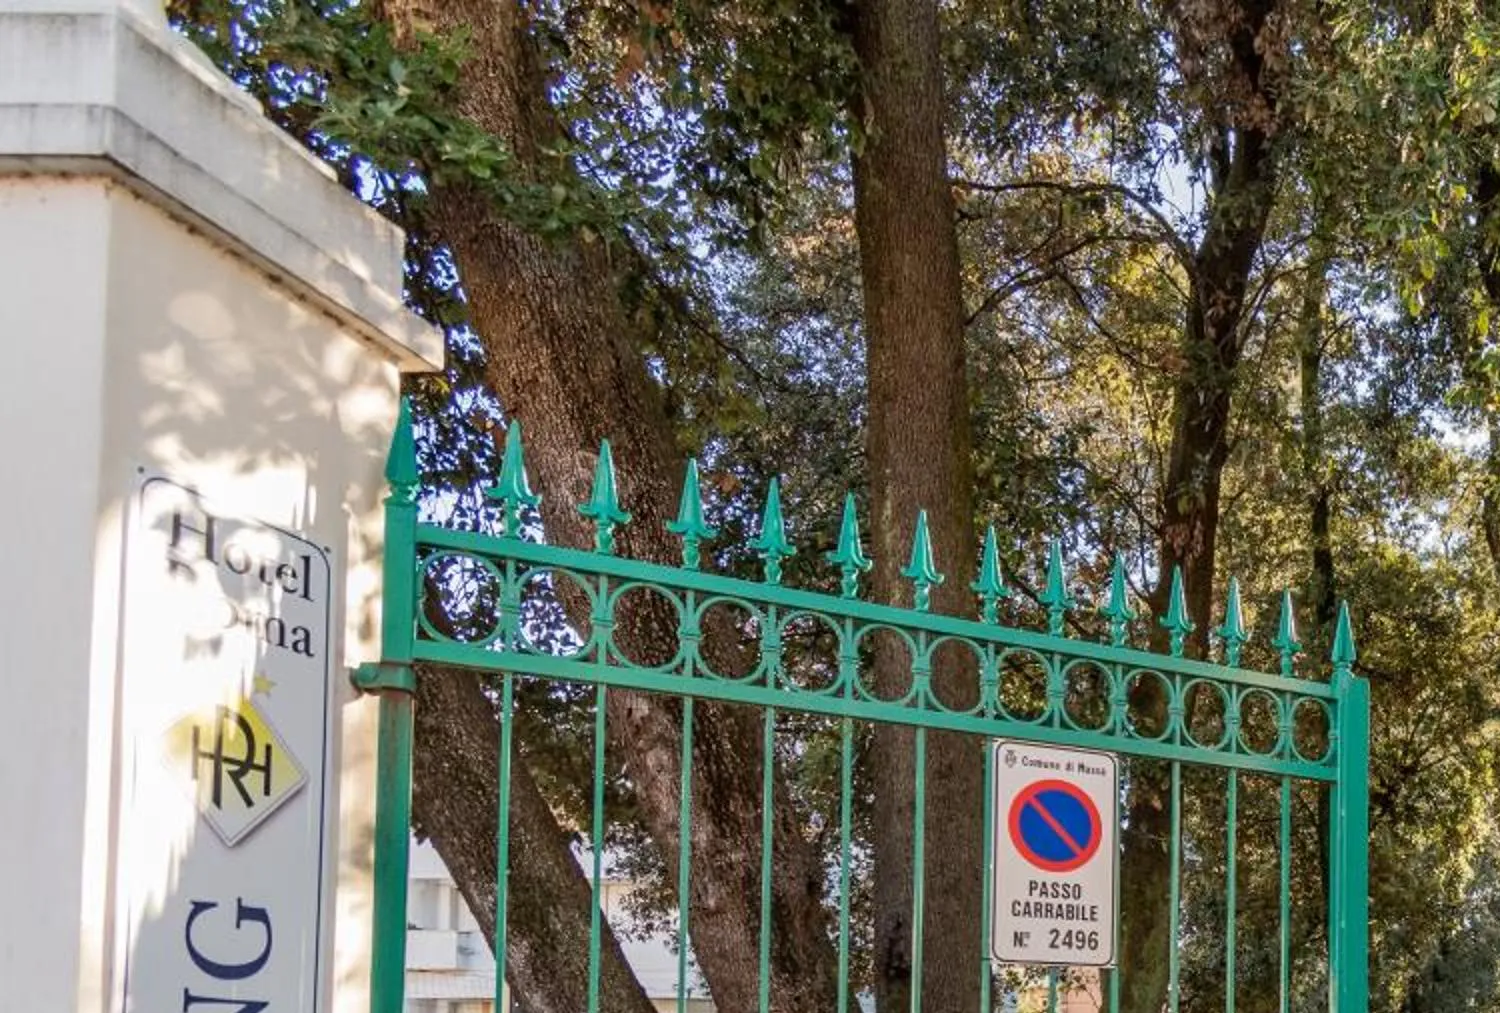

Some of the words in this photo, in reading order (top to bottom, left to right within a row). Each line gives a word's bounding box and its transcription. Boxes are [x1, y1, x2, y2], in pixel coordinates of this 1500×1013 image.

[1021, 755, 1060, 770] Comune
[1065, 761, 1075, 772] di
[1028, 880, 1081, 900] PASSO
[1011, 900, 1099, 922] CARRABILE
[1048, 928, 1099, 951] 2496
